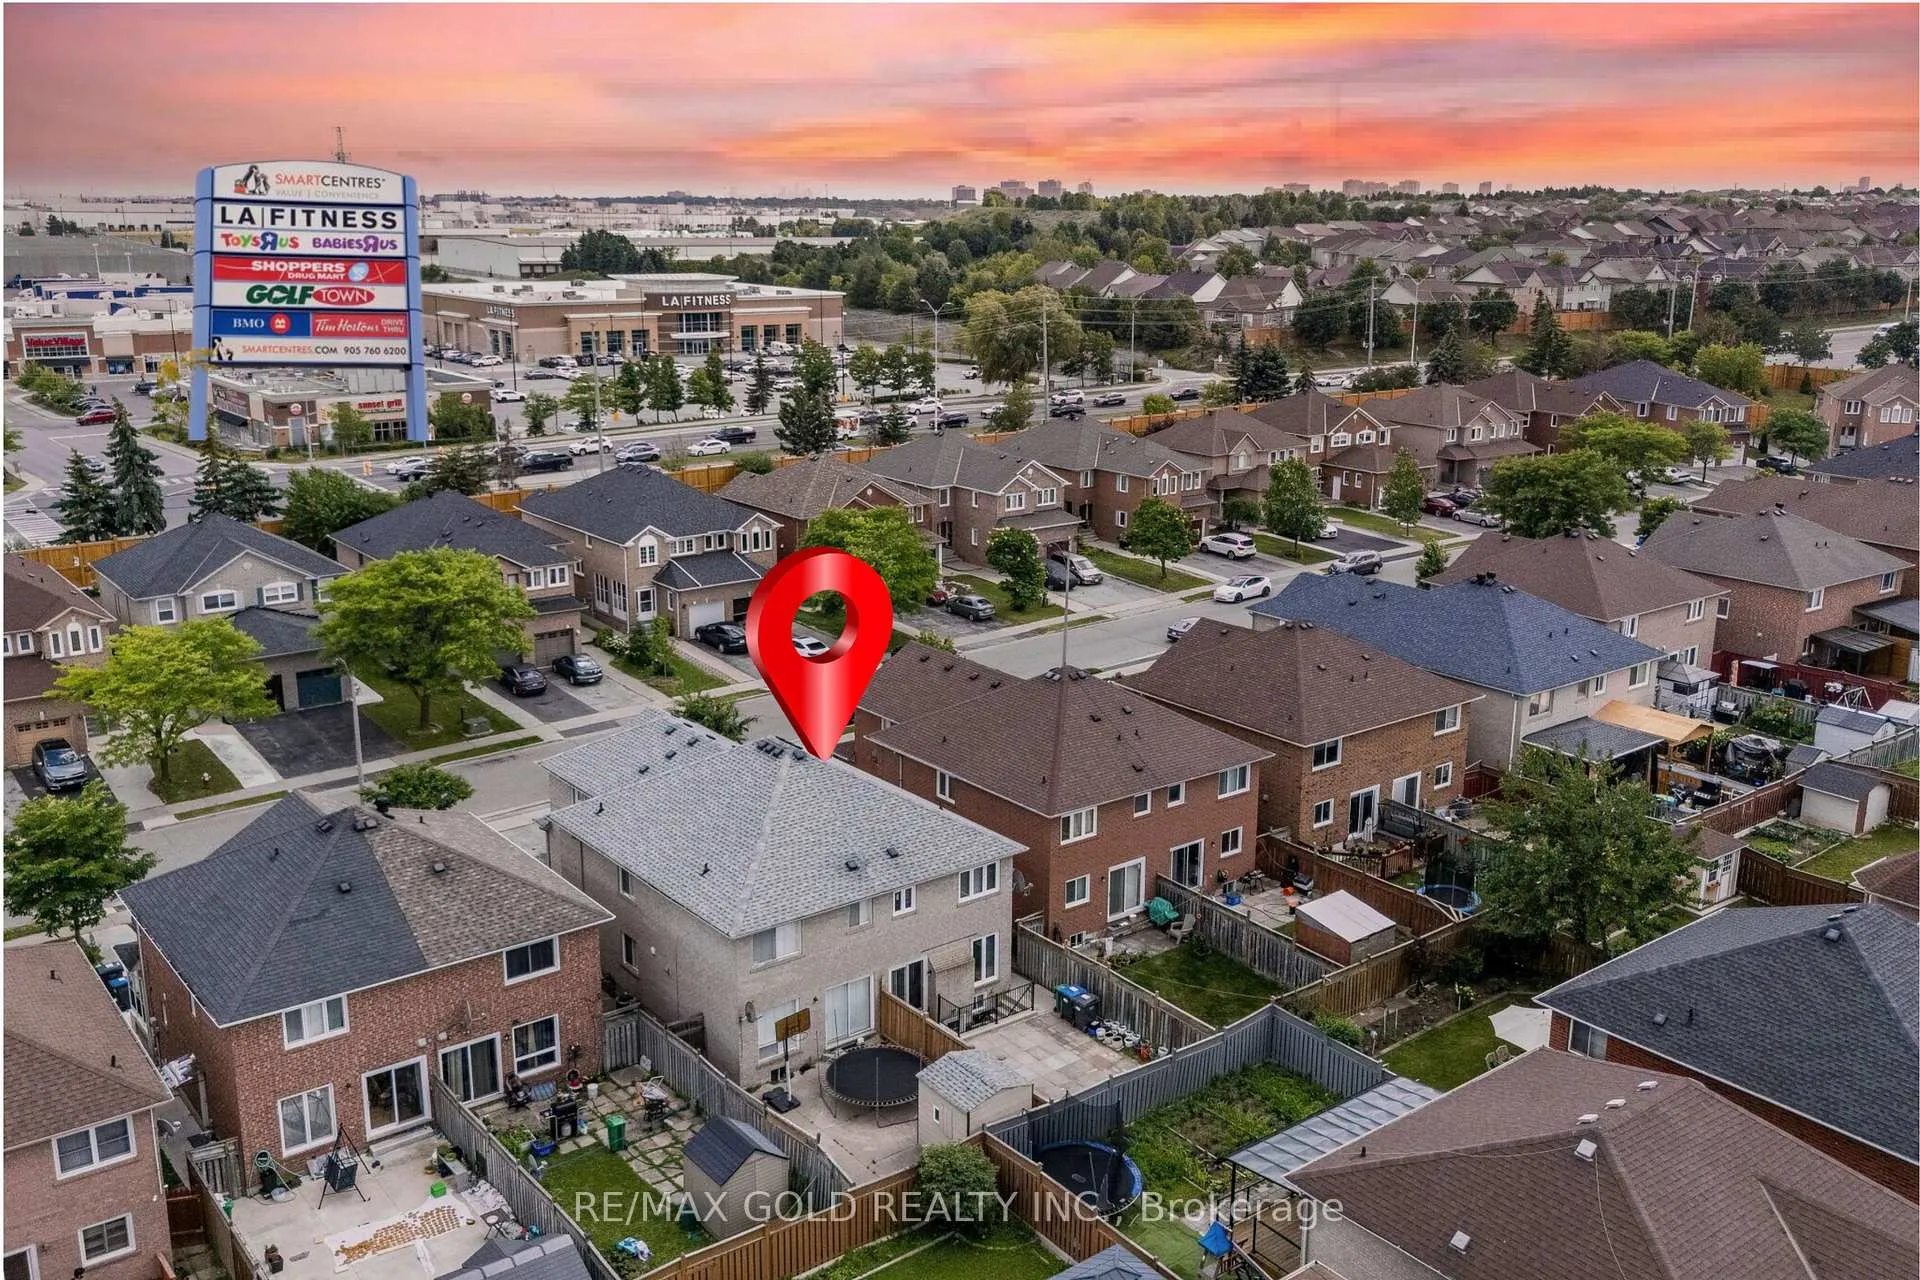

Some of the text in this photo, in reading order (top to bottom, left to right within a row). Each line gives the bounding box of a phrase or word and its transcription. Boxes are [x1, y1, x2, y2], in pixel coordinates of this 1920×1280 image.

[275, 173, 382, 189] SMARTCENTRES
[276, 189, 302, 198] VALUE
[220, 206, 397, 230] LA FITNESS
[251, 260, 346, 273] SHOPPERS
[287, 272, 346, 280] DRUG MART
[245, 284, 369, 305] GOLF TOWN
[661, 294, 731, 306] LA FITNESS
[232, 317, 265, 329] BMO
[315, 318, 379, 333] Tim Hortons
[380, 318, 405, 326] DRIVE
[382, 325, 405, 333] THRU
[343, 346, 361, 355] 905
[363, 347, 381, 355] 760
[383, 347, 407, 356] 6200
[358, 398, 403, 409] sunset grill
